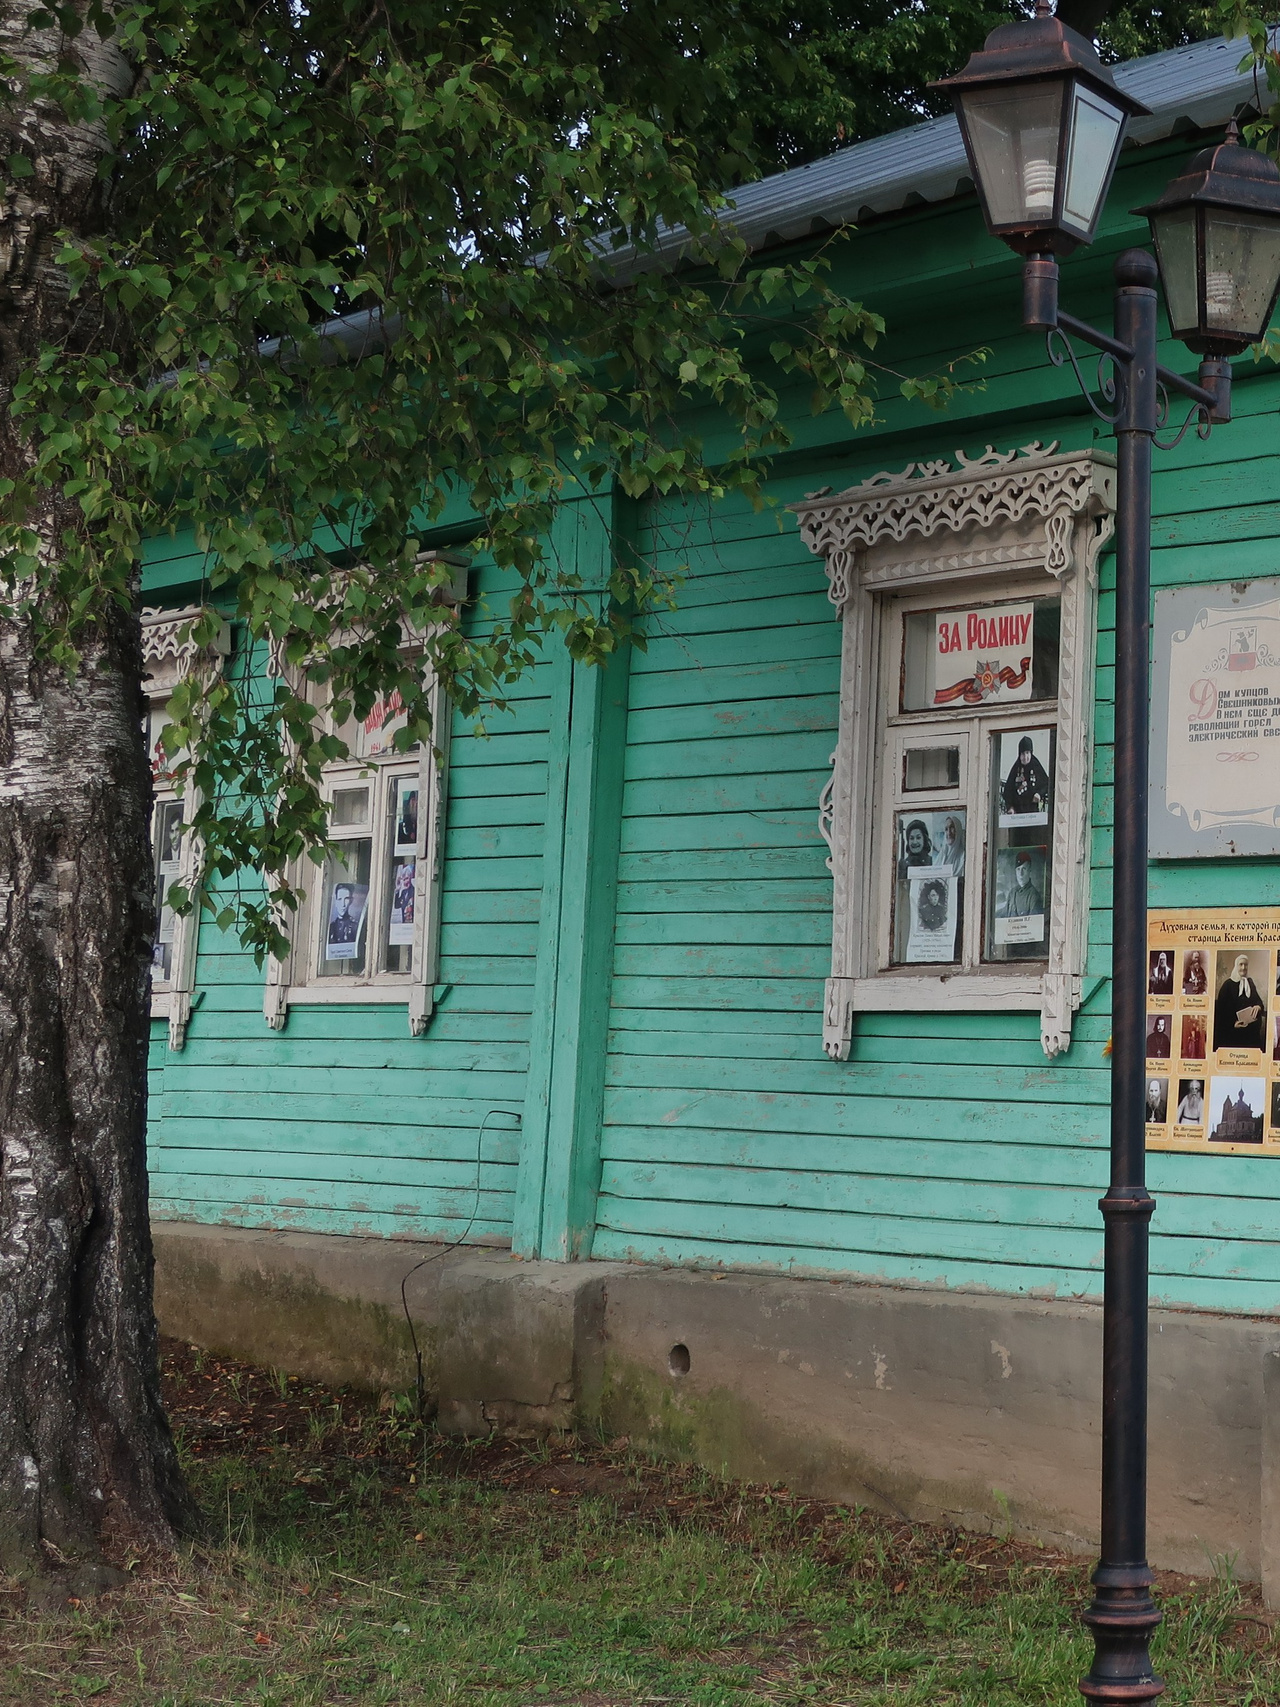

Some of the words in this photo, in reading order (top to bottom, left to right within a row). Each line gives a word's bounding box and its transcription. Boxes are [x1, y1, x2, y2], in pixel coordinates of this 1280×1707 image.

[939, 622, 962, 654] ЗА
[967, 613, 1032, 651] РОДИНУ
[1234, 687, 1269, 698] КУПЦОВ
[1216, 710, 1222, 719] В
[1247, 708, 1268, 718] ЕЩЕ
[1188, 720, 1240, 732] РЕВОЛЮЦИИ
[1243, 718, 1272, 728] ГОРЕЛ
[1159, 921, 1199, 934] Духовная
[1200, 923, 1228, 931] семья,
[1236, 921, 1270, 932] которой
[1187, 935, 1222, 944] старица
[1224, 933, 1254, 943] Ксения
